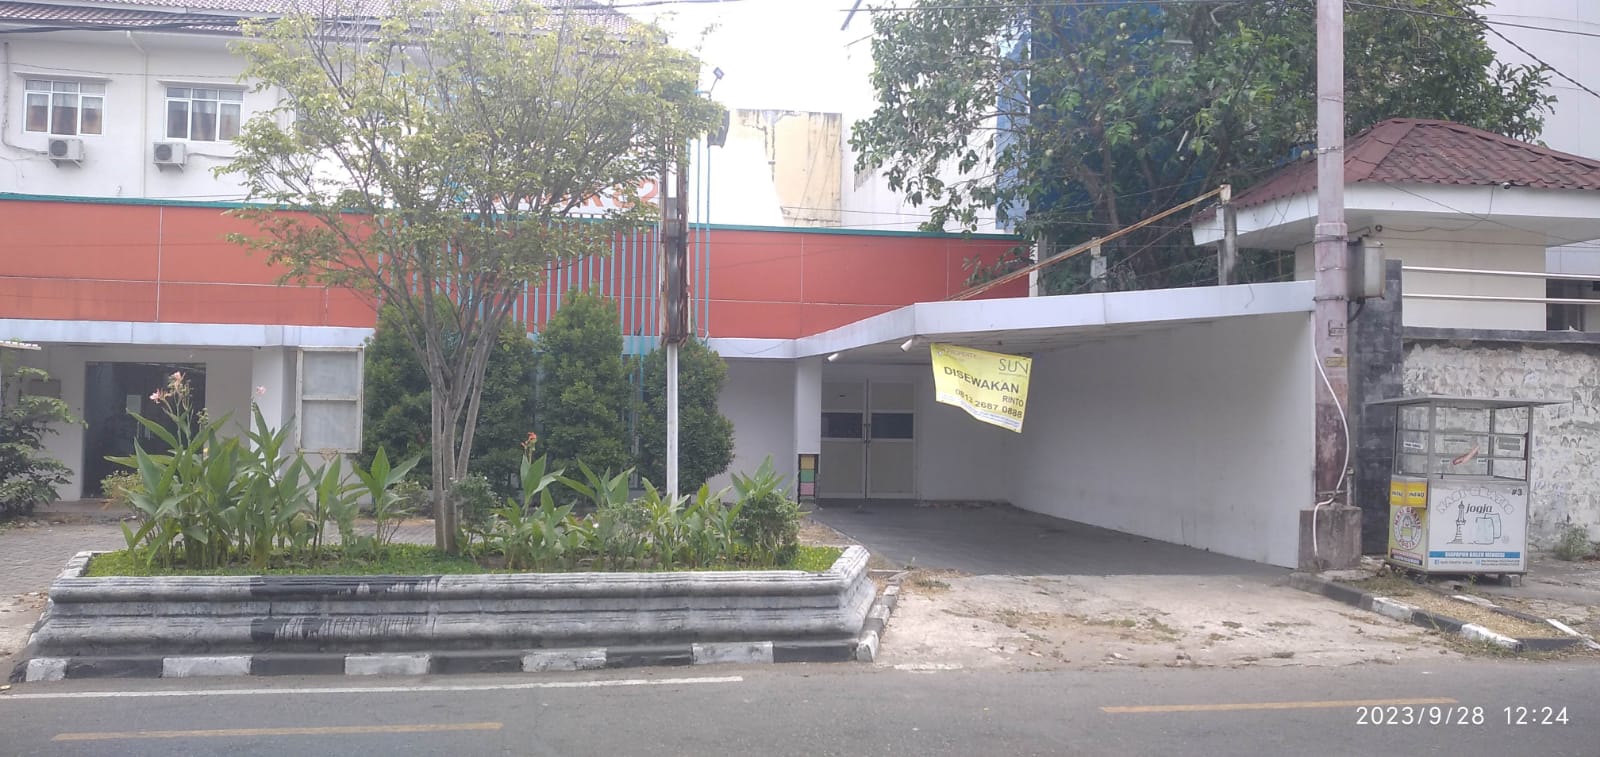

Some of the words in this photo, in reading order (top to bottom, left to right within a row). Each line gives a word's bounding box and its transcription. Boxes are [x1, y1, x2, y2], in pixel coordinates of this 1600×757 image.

[999, 358, 1029, 375] SUN
[944, 366, 1019, 394] DISEWAKAN
[955, 388, 974, 404] 0812
[975, 400, 999, 411] 2687
[1002, 406, 1023, 418] 0888
[1002, 395, 1024, 407] RINTO
[1511, 488, 1523, 496] #3
[1465, 503, 1493, 514] jogja
